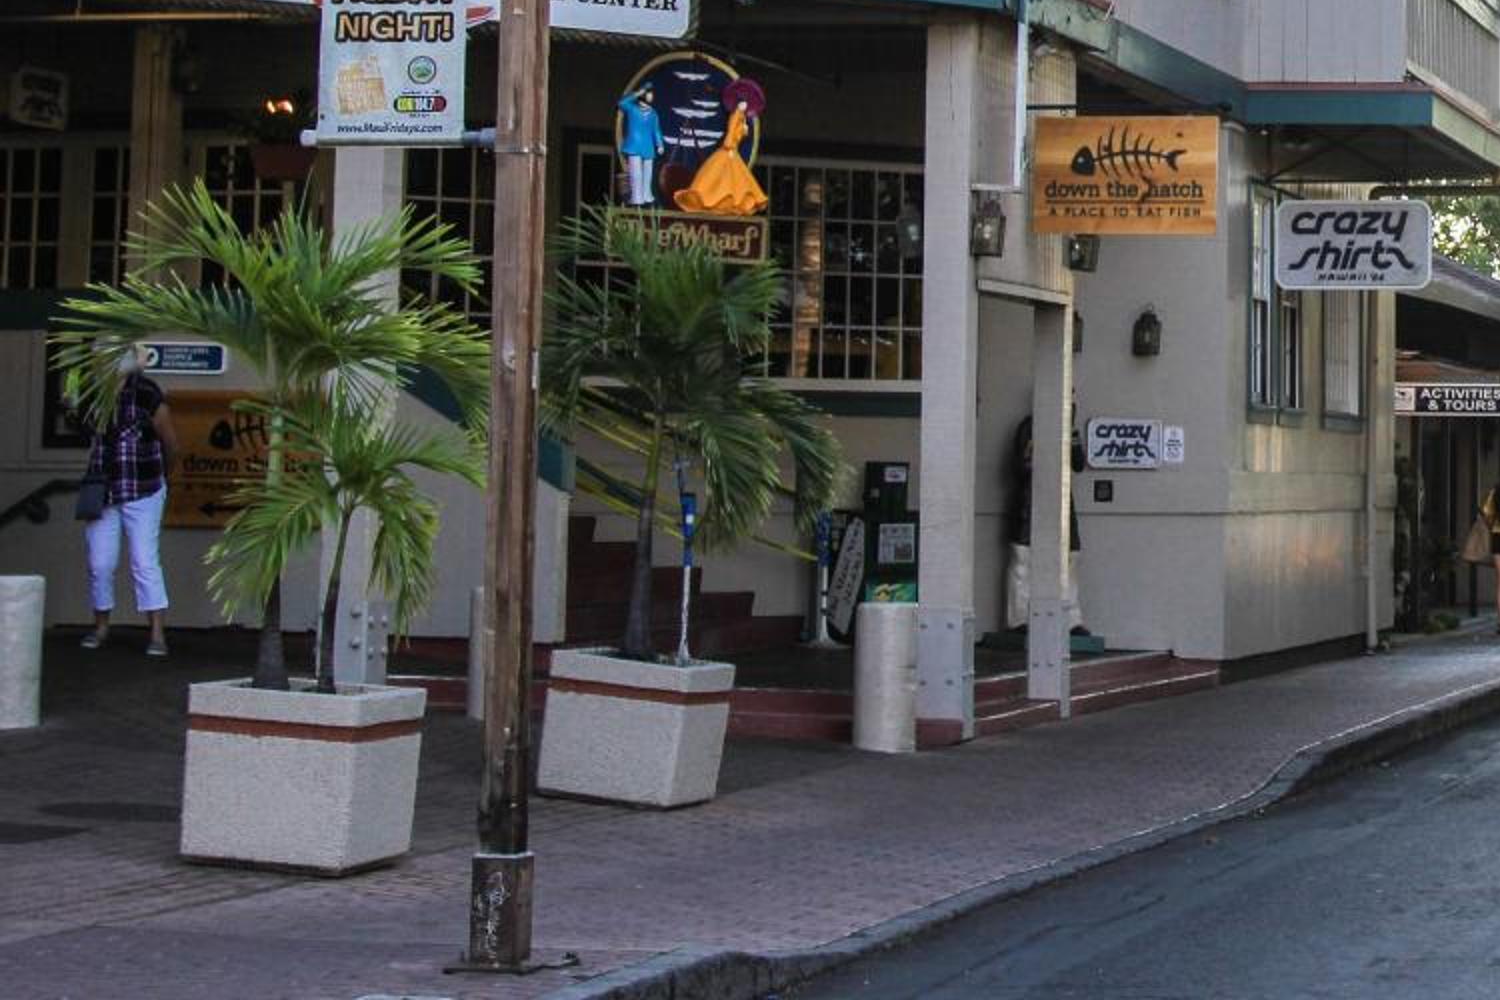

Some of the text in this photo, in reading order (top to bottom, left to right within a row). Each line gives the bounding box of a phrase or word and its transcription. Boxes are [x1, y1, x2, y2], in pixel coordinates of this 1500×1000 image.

[335, 10, 454, 43] NIGHT!
[1044, 178, 1205, 199] down the hatch
[1063, 207, 1105, 217] PLACE
[1112, 207, 1129, 217] TO
[1136, 207, 1162, 217] EAT
[1169, 207, 1201, 217] FISH
[1291, 210, 1409, 242] crazy
[1427, 399, 1498, 411] & TOURS
[1096, 424, 1152, 442] crazy
[183, 452, 239, 473] down
